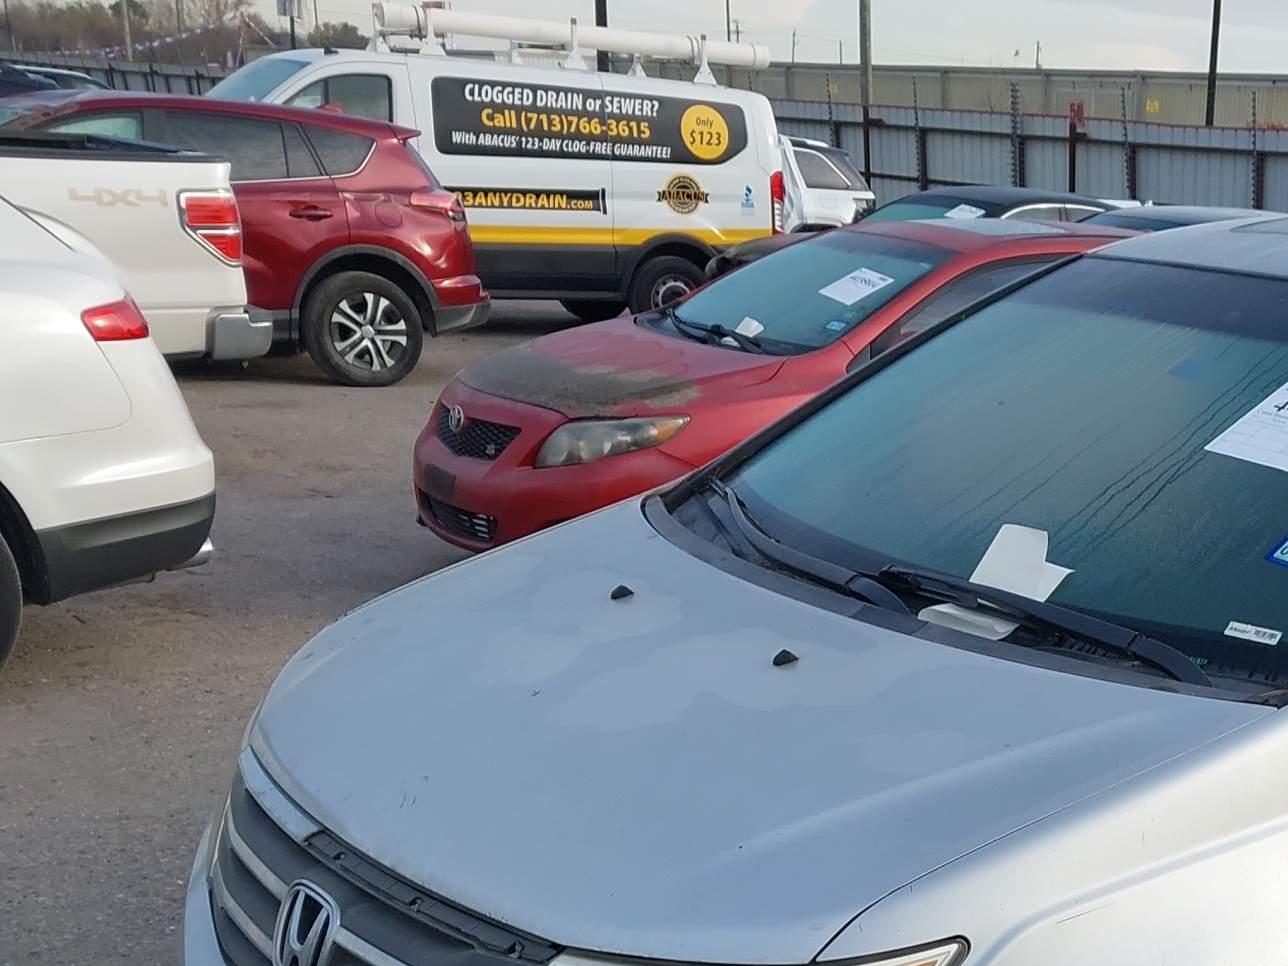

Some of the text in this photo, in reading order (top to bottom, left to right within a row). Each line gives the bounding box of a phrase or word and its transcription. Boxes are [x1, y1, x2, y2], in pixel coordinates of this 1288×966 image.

[464, 83, 659, 117] CLOGGED DRAIN or SEWER?
[481, 108, 650, 138] Call (713)766-3615
[695, 116, 714, 129] Only
[452, 131, 476, 145] With
[521, 137, 562, 152] 123-DAY
[562, 139, 613, 155] CLOG-FREE
[613, 143, 672, 159] GUARANTEE!
[689, 129, 722, 146] $123
[661, 190, 705, 201] ABACUS
